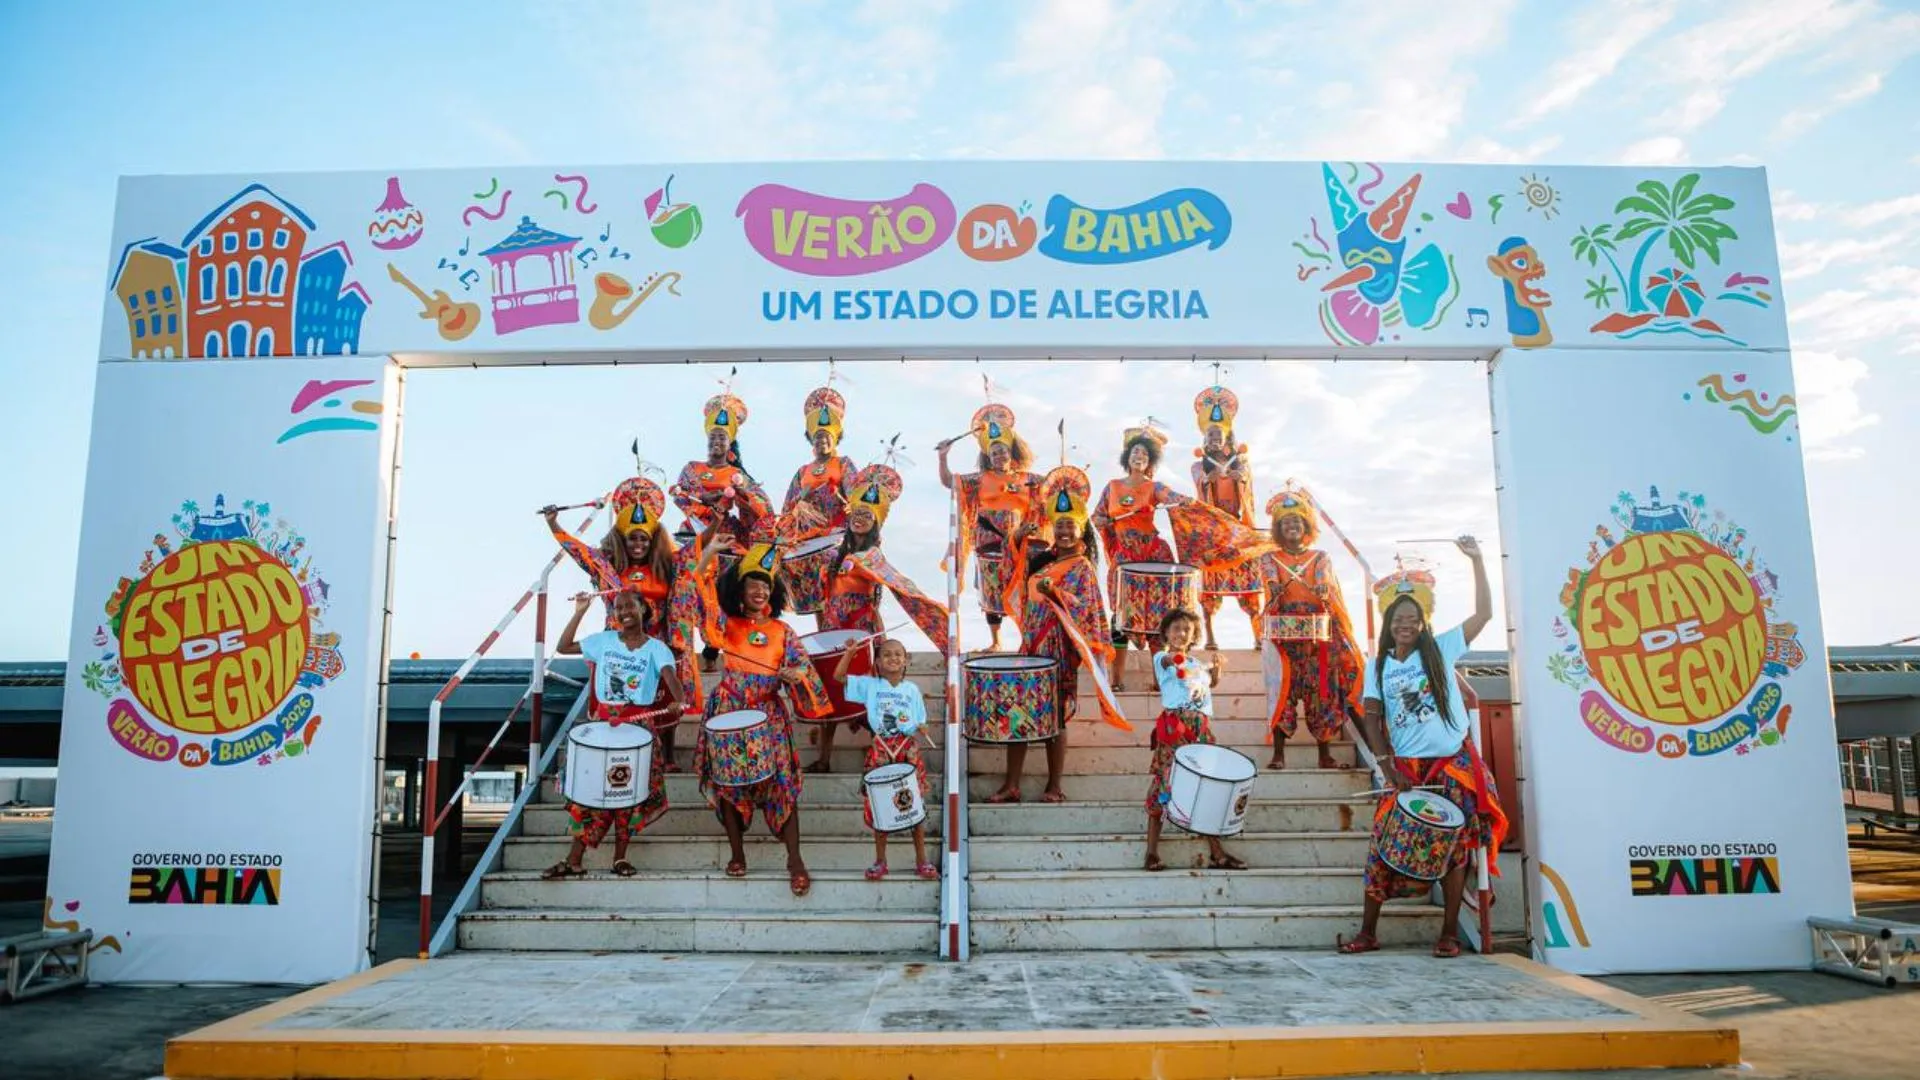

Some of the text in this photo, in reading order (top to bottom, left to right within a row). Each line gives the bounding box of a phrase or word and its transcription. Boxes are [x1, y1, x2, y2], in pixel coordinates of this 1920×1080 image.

[770, 200, 1214, 260] VERÃO DA BAHIA
[762, 289, 1209, 321] UM ESTADO DE ALEGRIA
[151, 541, 261, 588] UM
[1599, 533, 1705, 580] UM
[123, 563, 304, 659] ESTADO
[1581, 554, 1756, 650] ESTADO
[180, 628, 247, 662] DE
[1639, 618, 1705, 653] DE
[134, 623, 306, 733] ALEGRIA
[1598, 614, 1766, 724] ALEGRIA
[110, 695, 313, 762] VERÃO DA BAHIA 2026
[1585, 684, 1782, 754] VERÃO DA BAHIA 2026
[132, 853, 283, 867] GOVERNO DO ESTADO
[1628, 842, 1777, 858] GOVERNO DO ESTADO
[129, 867, 281, 905] BAHIA
[1630, 857, 1781, 896] BAHIA
